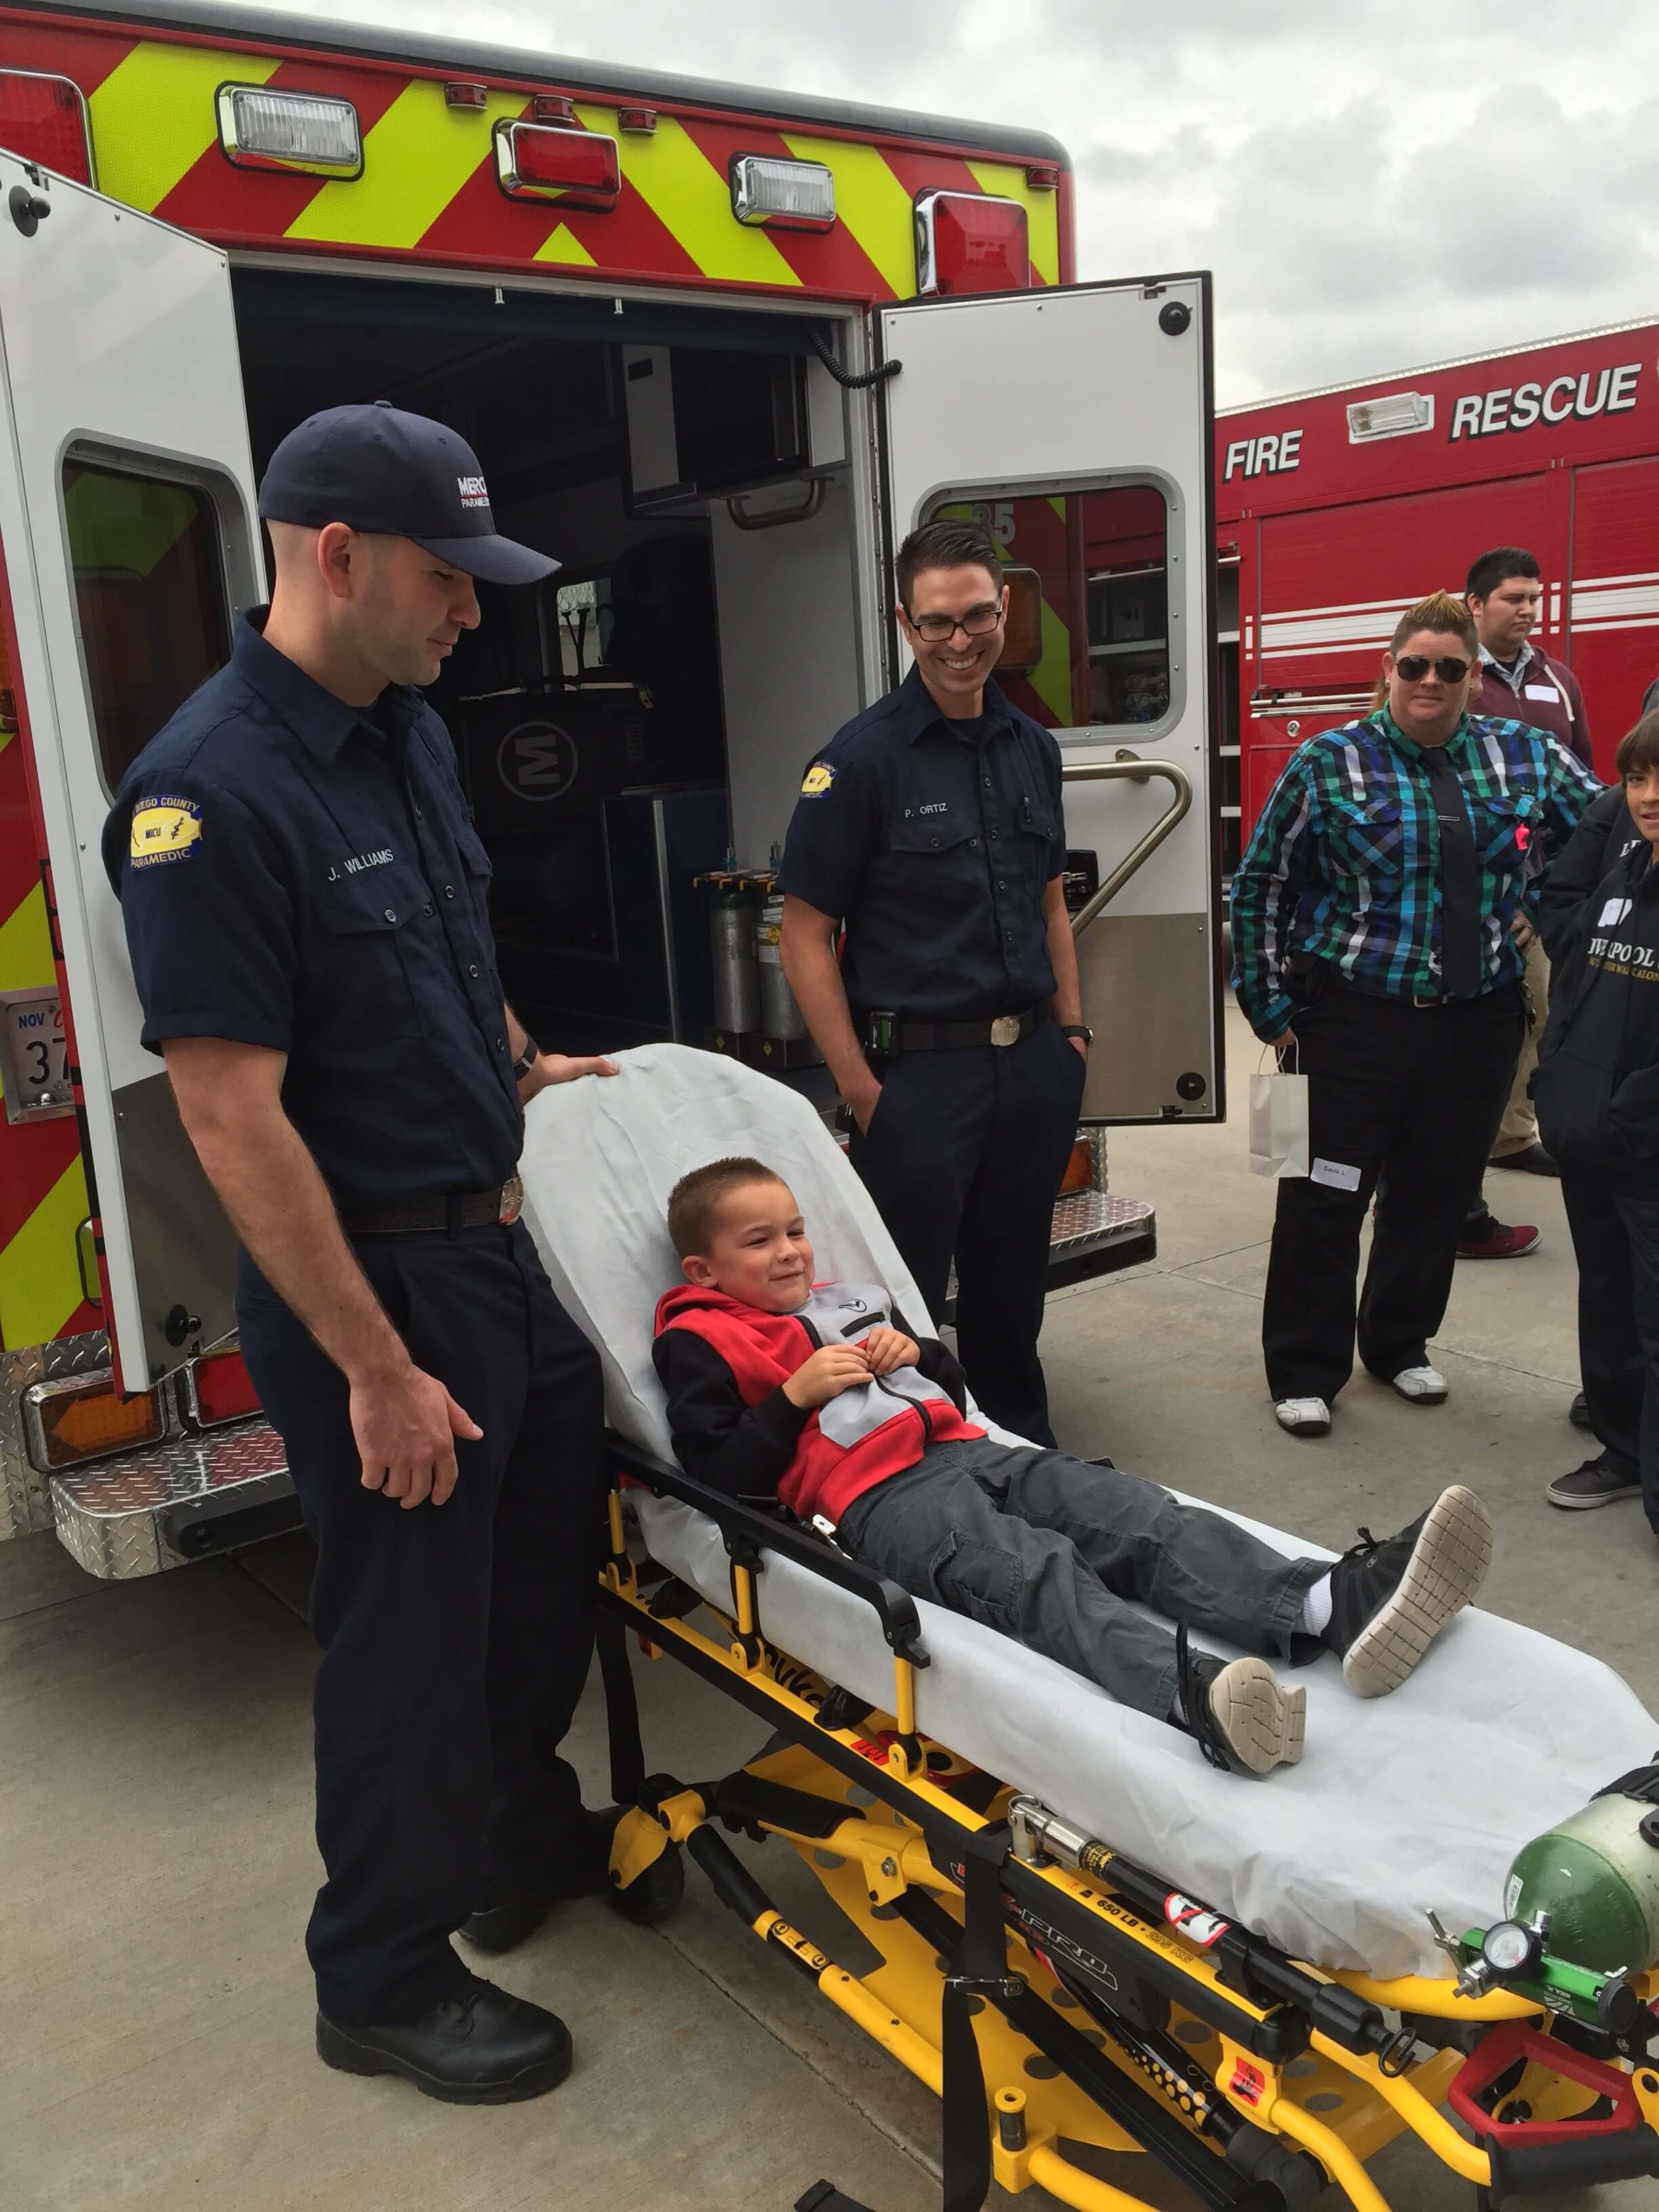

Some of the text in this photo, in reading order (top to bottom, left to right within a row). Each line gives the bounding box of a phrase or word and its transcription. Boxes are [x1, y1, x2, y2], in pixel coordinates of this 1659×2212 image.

[1451, 363, 1642, 442] RESCUE
[1225, 429, 1303, 480] FIRE
[161, 797, 201, 813] COUNTY
[905, 802, 948, 818] P. ORTIZ
[327, 848, 394, 881] J. WILLIAMS
[18, 1013, 45, 1028] NOV
[1097, 1900, 1121, 1915] 650
[1120, 1914, 1139, 1927] LB
[1171, 1947, 1193, 1964] KG
